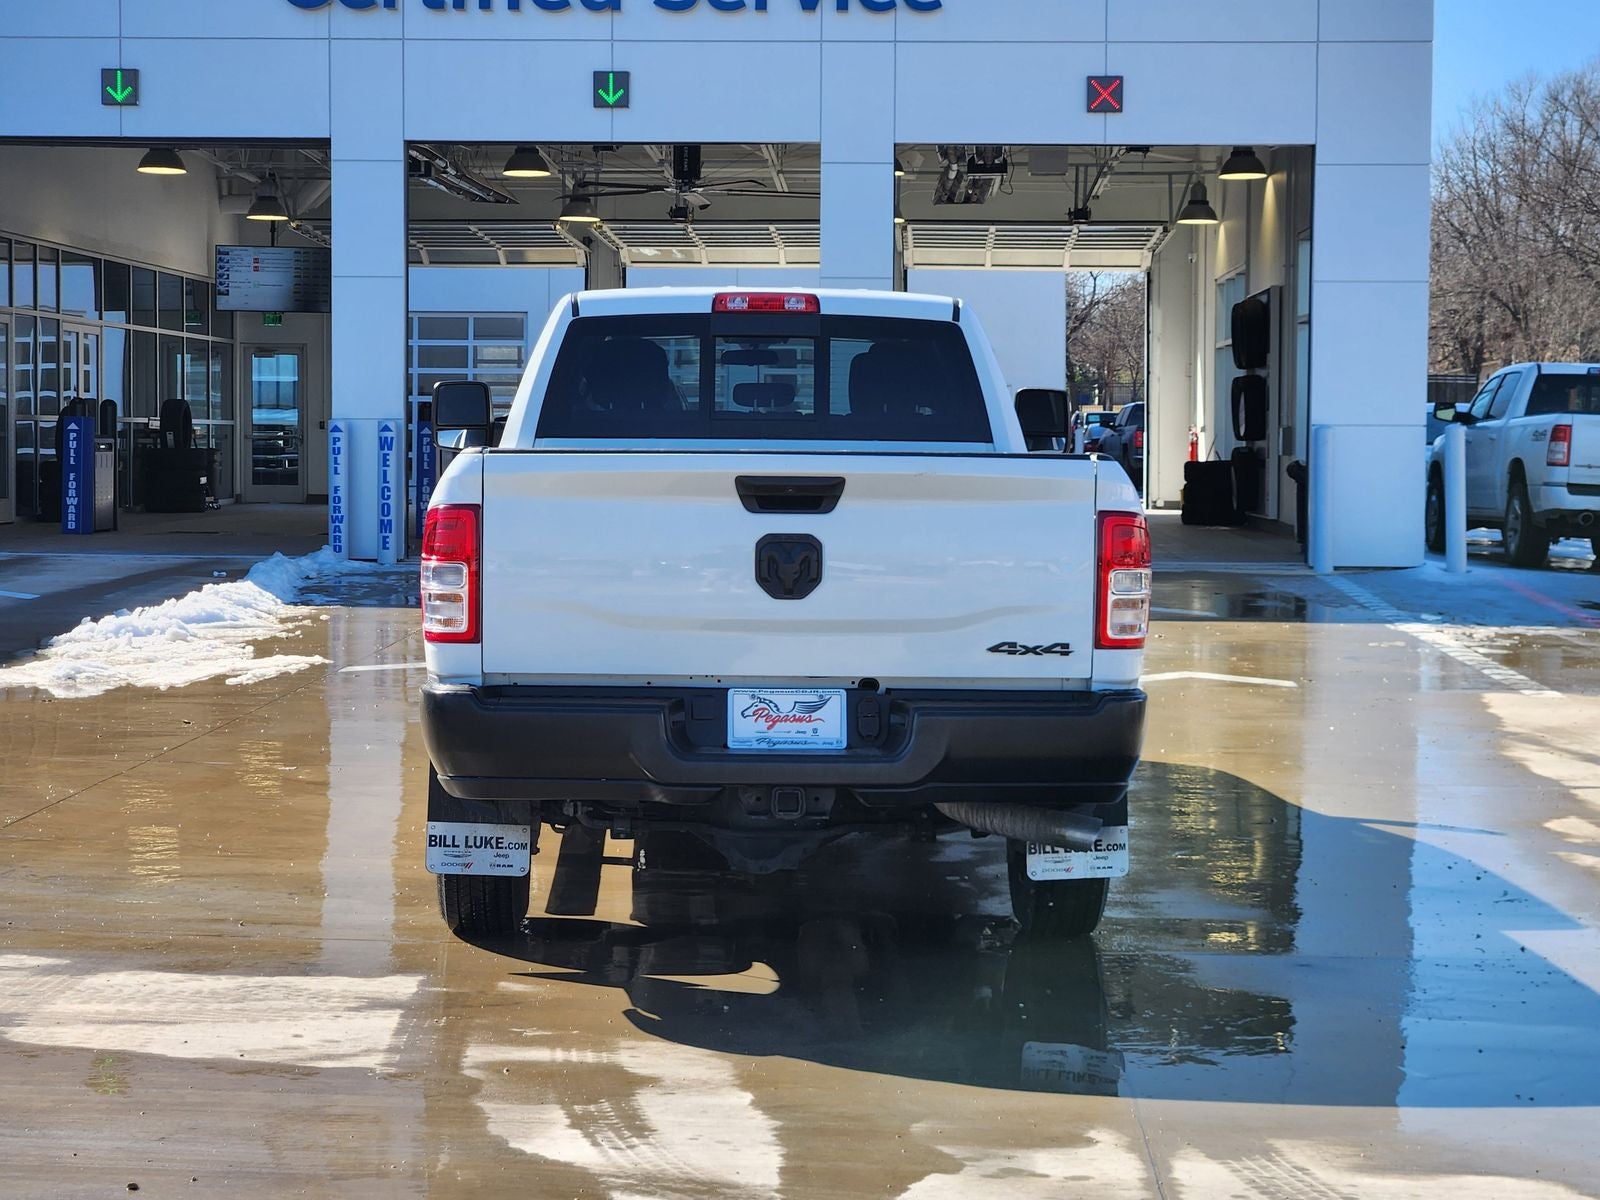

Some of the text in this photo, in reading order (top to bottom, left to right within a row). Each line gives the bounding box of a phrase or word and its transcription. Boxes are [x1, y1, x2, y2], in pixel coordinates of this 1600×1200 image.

[423, 436, 431, 470] PULL
[65, 432, 79, 530] PULL FORWARD
[330, 436, 345, 554] PULL FORWARD
[379, 436, 395, 551] WELCOME
[985, 641, 1075, 656] 4x4
[752, 707, 825, 731] Pegasus
[428, 834, 528, 851] BILL LUKE.COM
